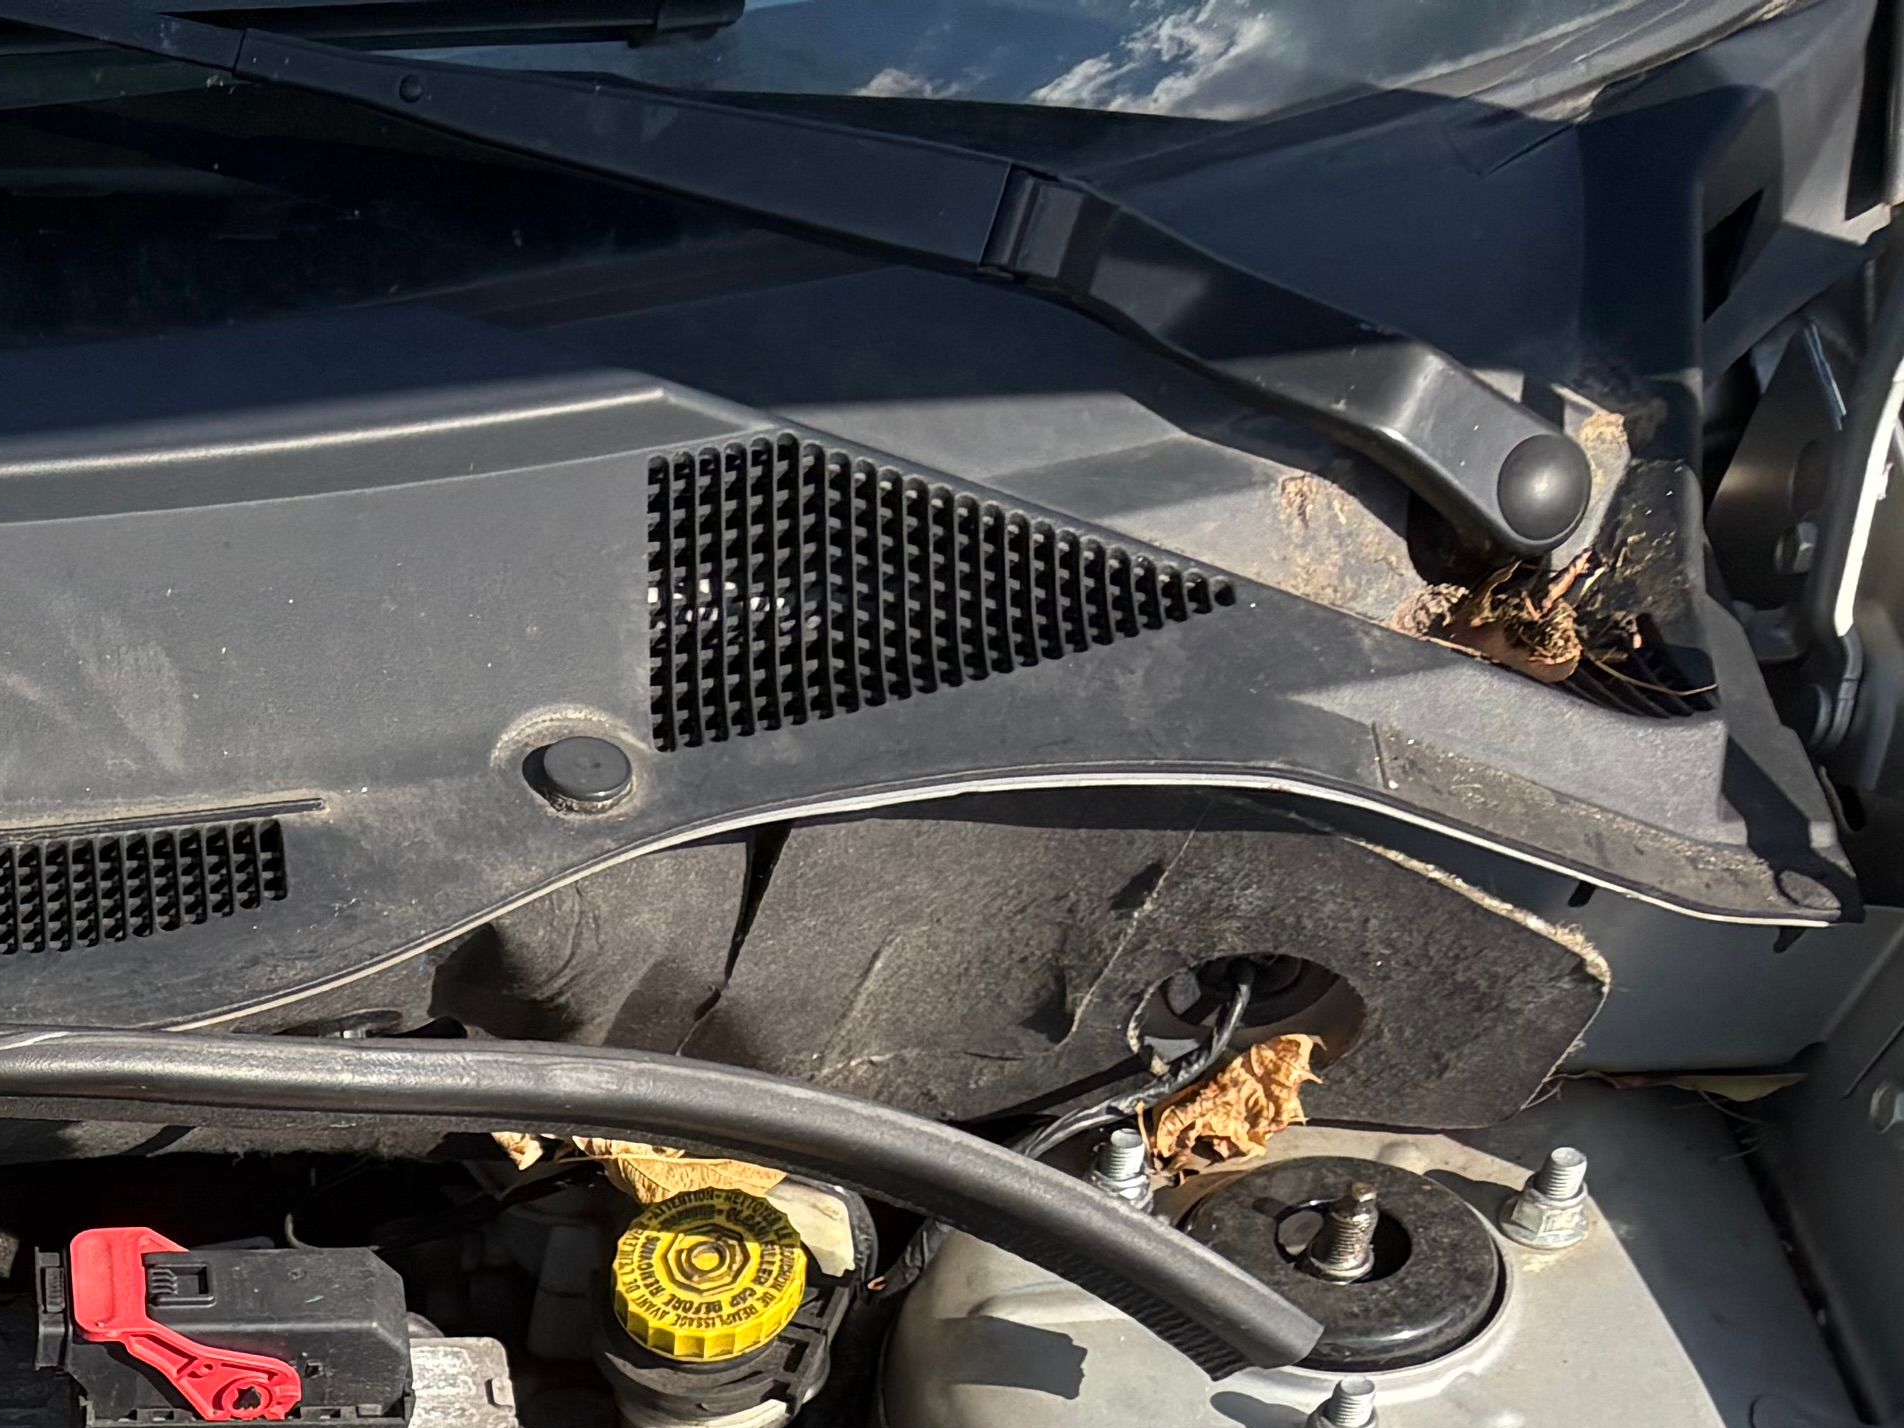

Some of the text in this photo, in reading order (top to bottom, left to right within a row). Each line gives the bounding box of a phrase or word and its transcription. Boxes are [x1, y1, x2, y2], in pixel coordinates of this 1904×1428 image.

[623, 1278, 641, 1294] DE
[729, 1286, 759, 1307] CAP
[636, 1295, 668, 1322] AVANT
[663, 1293, 724, 1316] BEFORE
